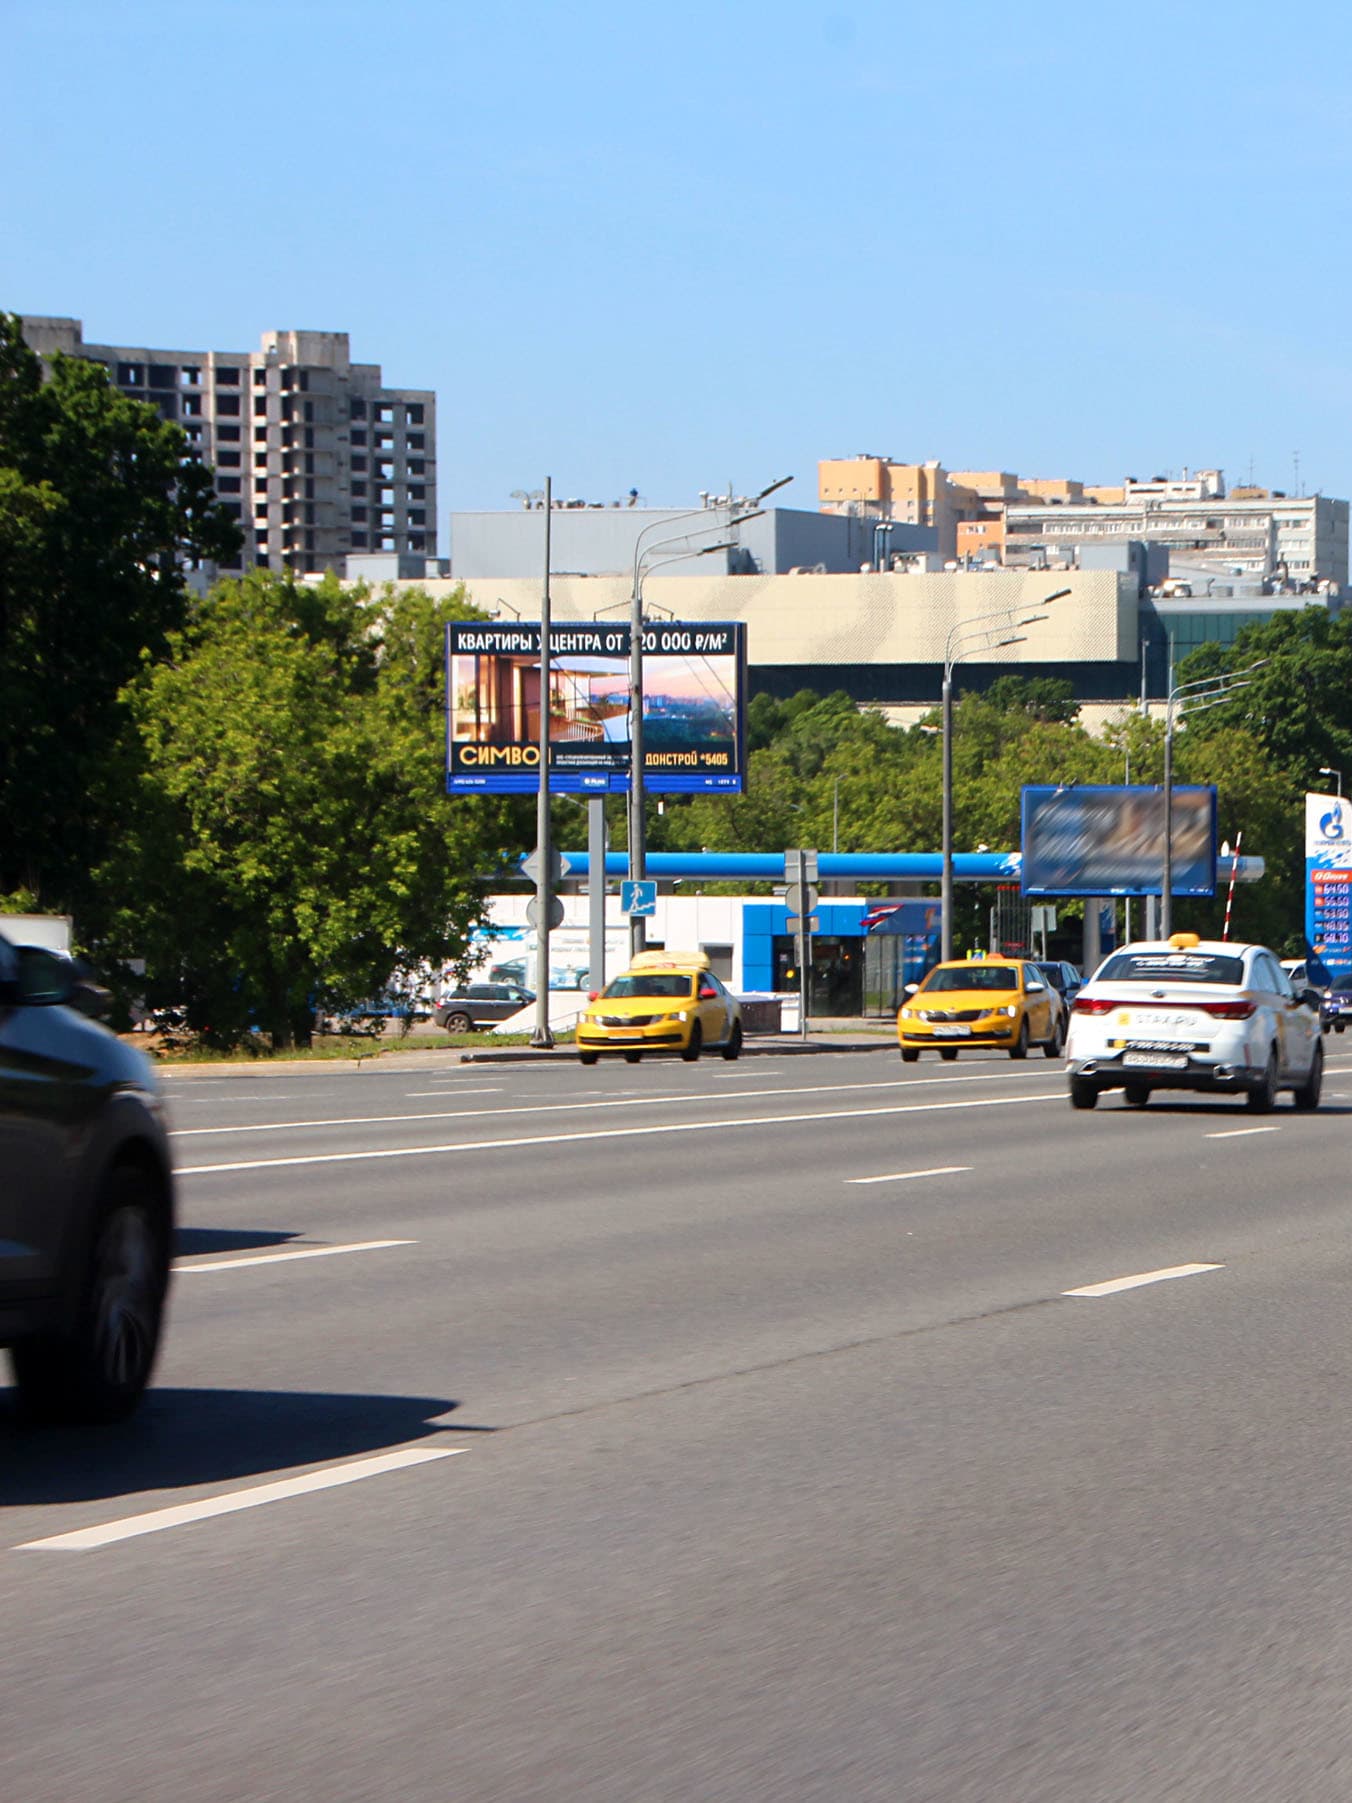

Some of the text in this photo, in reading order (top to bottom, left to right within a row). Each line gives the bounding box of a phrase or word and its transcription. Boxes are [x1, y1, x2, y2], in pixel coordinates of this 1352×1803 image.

[458, 634, 531, 651] КВАРТИРЫ
[549, 633, 601, 654] ЦЕНТРА
[606, 634, 623, 650] ОТ
[628, 632, 656, 651] 20
[660, 632, 691, 651] 000
[459, 746, 550, 765] СИМВО
[645, 751, 698, 766] ДОНСТРОЙ
